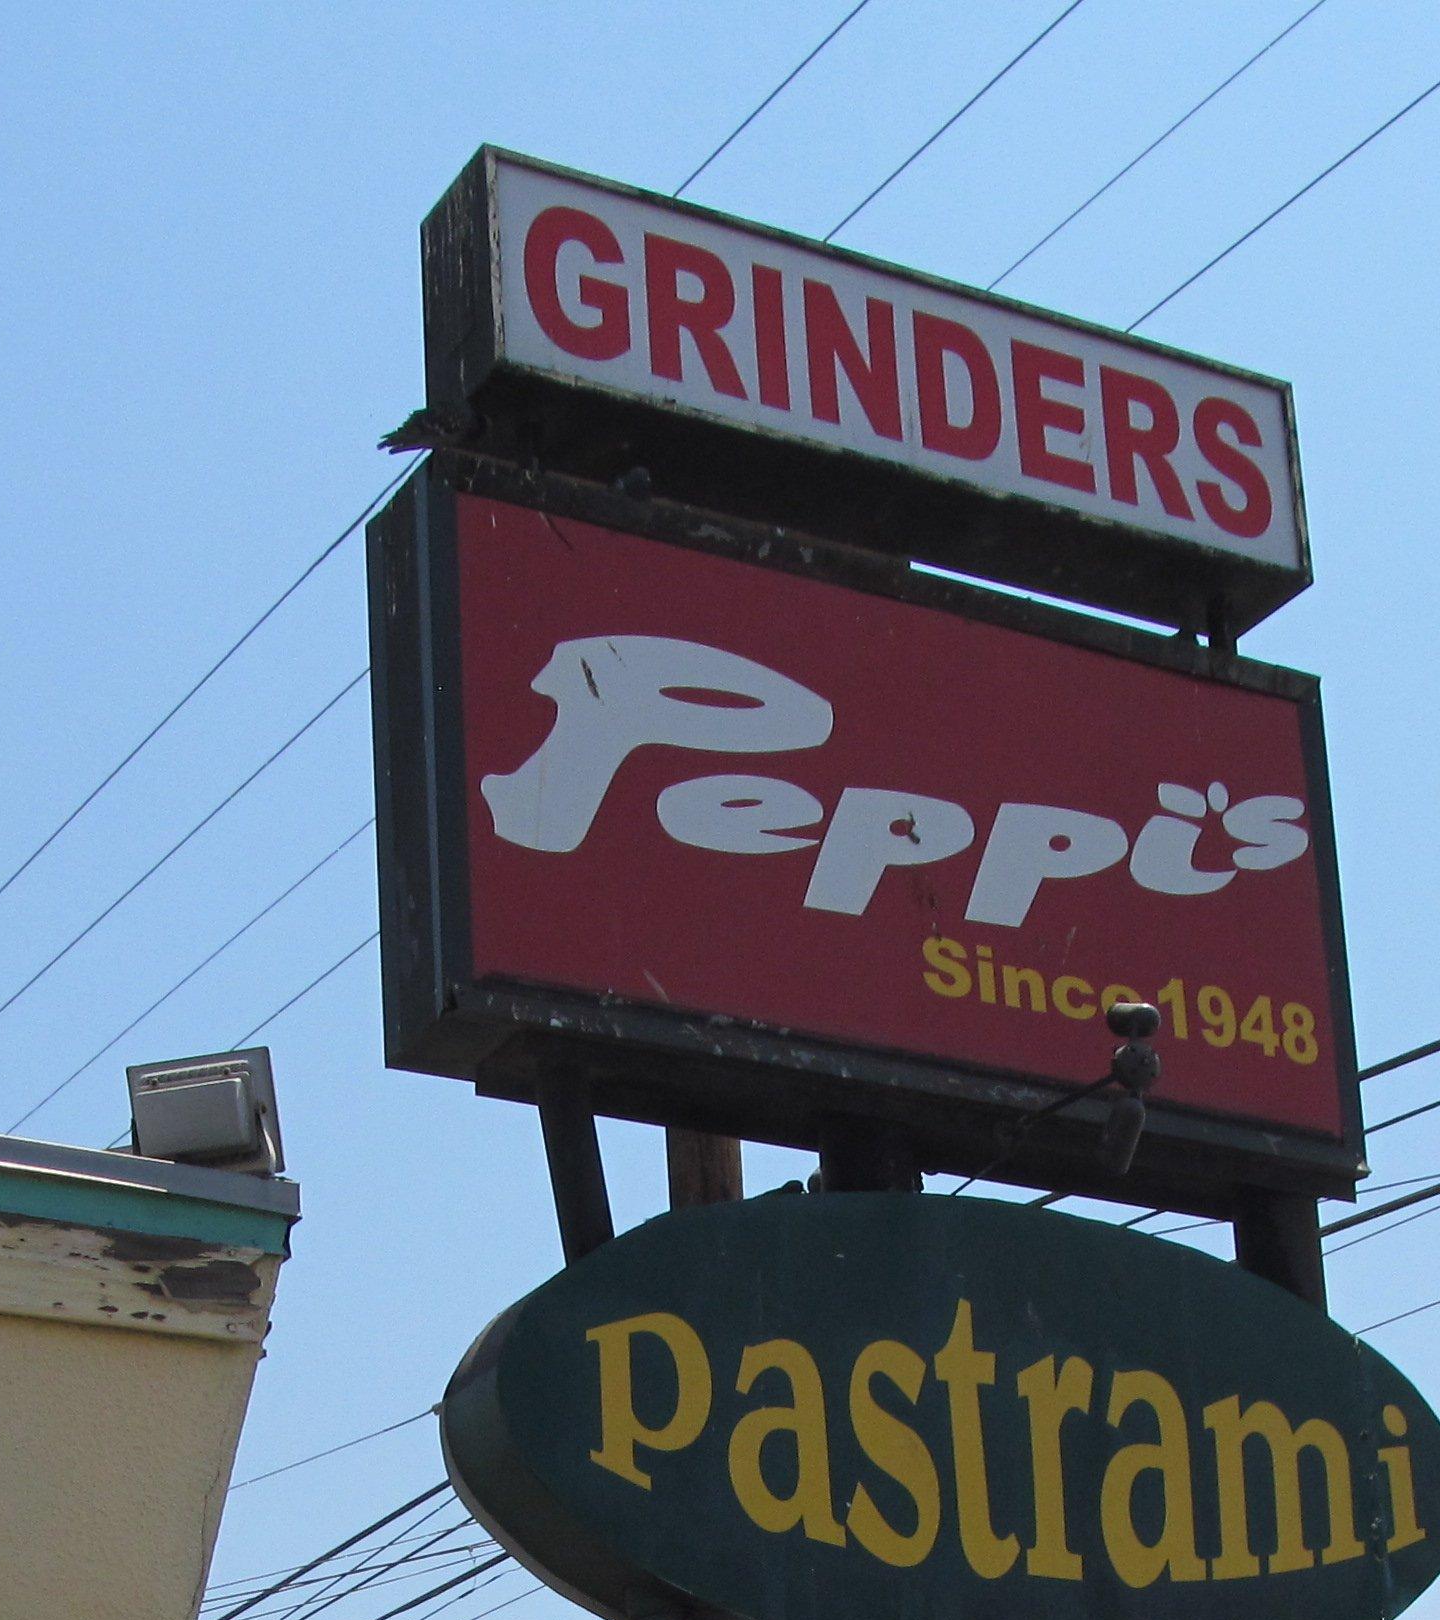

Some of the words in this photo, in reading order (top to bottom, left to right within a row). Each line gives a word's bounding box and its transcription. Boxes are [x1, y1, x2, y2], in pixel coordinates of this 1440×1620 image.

[524, 206, 1273, 538] GRINDERS
[480, 633, 1310, 928] Peppi's
[1157, 978, 1319, 1065] 1948
[585, 1298, 1426, 1589] pastrami
